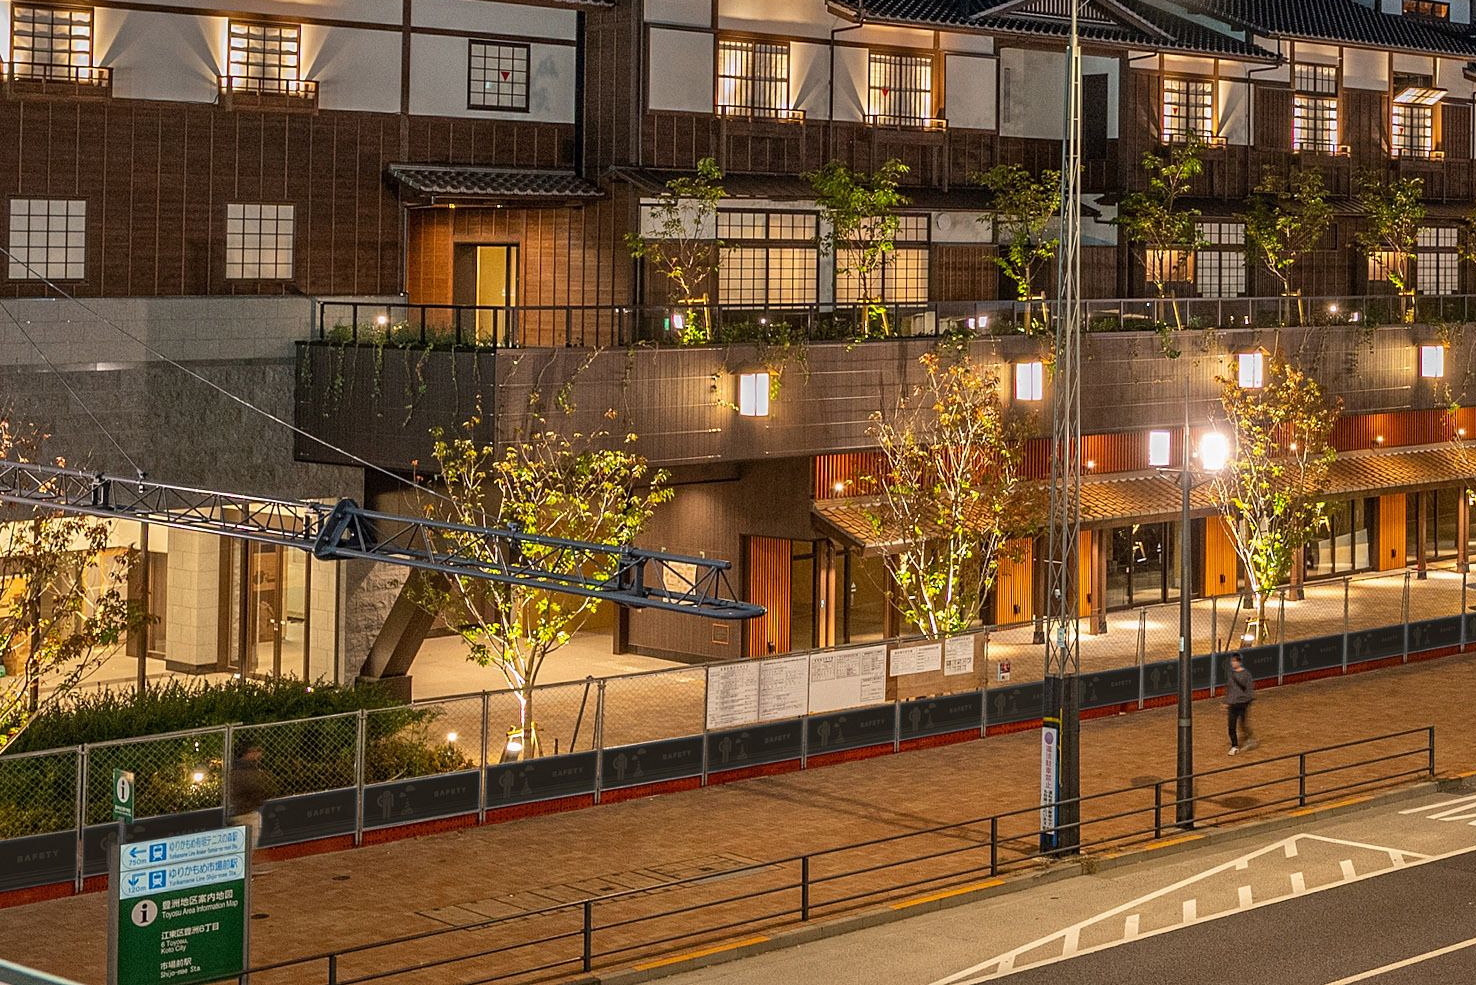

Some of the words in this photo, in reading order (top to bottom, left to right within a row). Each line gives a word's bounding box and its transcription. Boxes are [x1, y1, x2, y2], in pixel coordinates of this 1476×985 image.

[162, 910, 182, 920] Toyosu
[182, 906, 196, 916] Area
[196, 901, 226, 913] Information
[226, 899, 239, 909] Map
